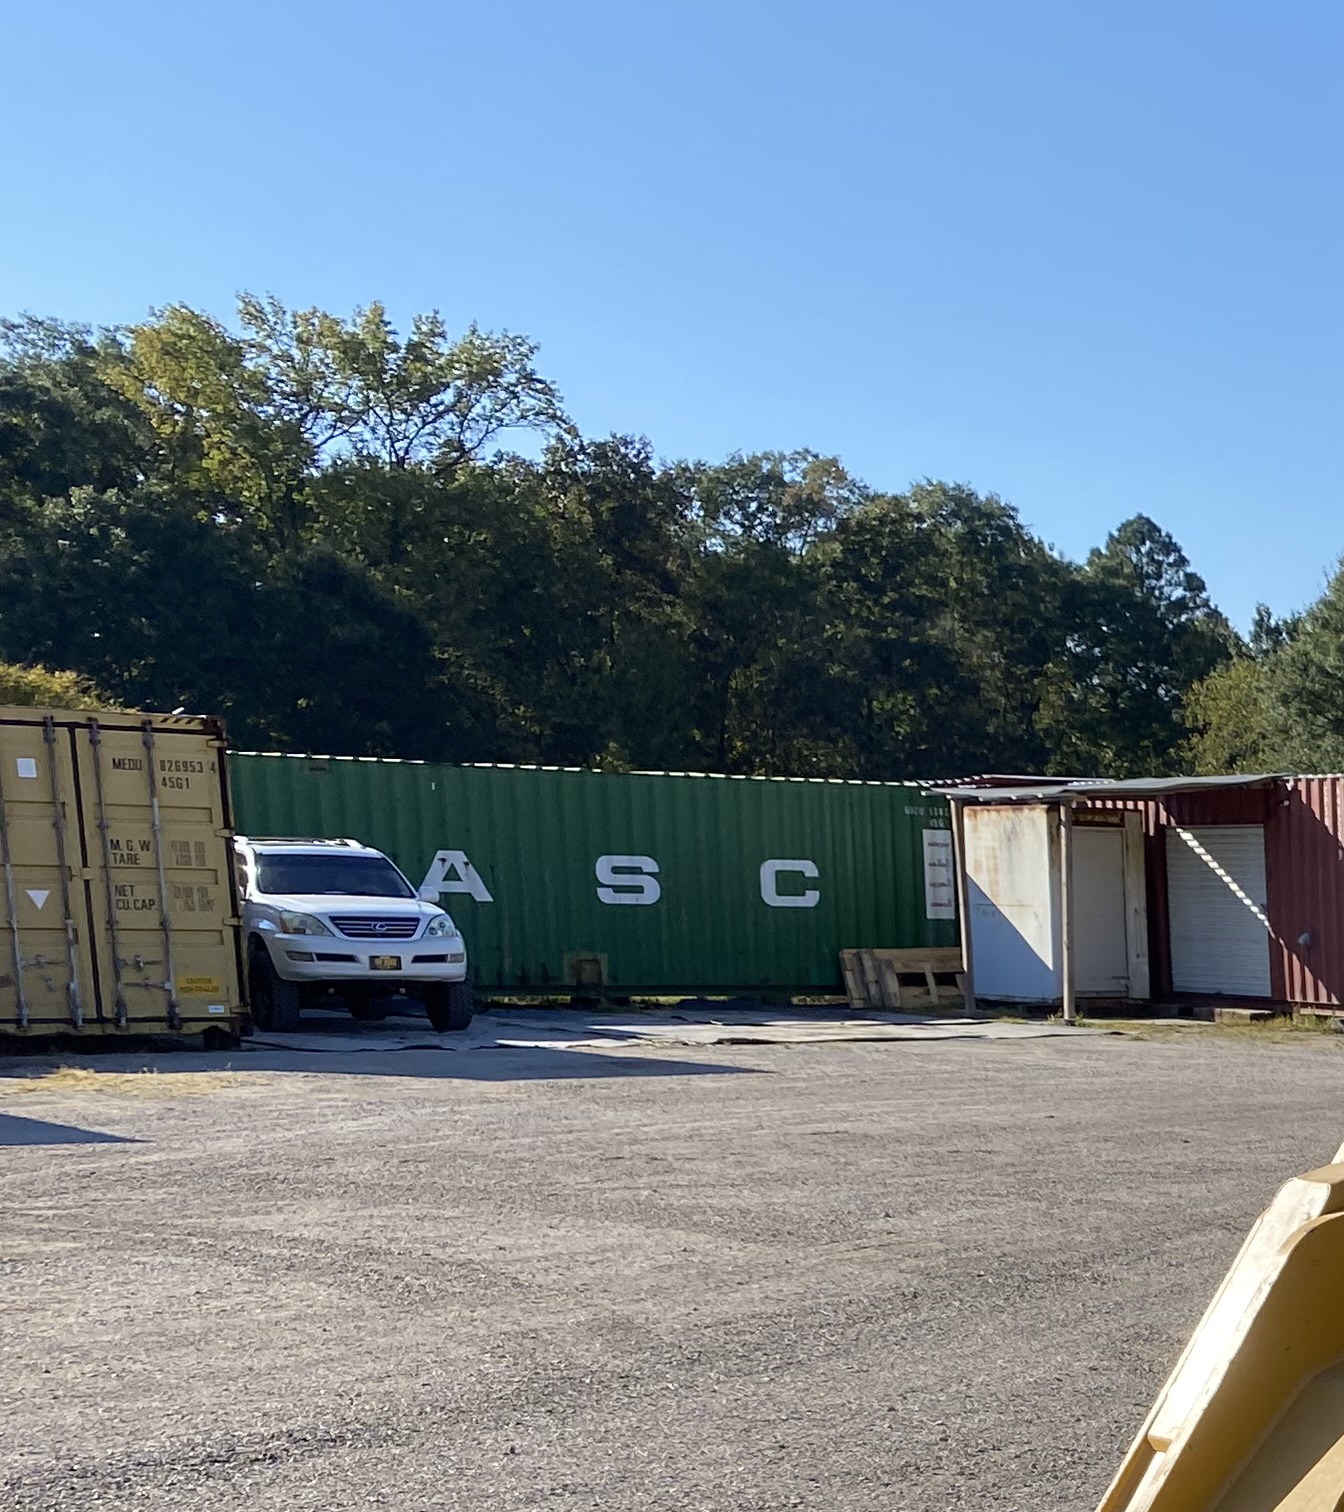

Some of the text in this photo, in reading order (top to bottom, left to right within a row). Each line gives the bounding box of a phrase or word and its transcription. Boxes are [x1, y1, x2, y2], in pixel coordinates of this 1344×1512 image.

[112, 757, 142, 771] MEDU
[160, 759, 203, 773] 826953
[161, 777, 190, 789] 45G1
[112, 852, 140, 865] TARE
[114, 884, 135, 897] NET
